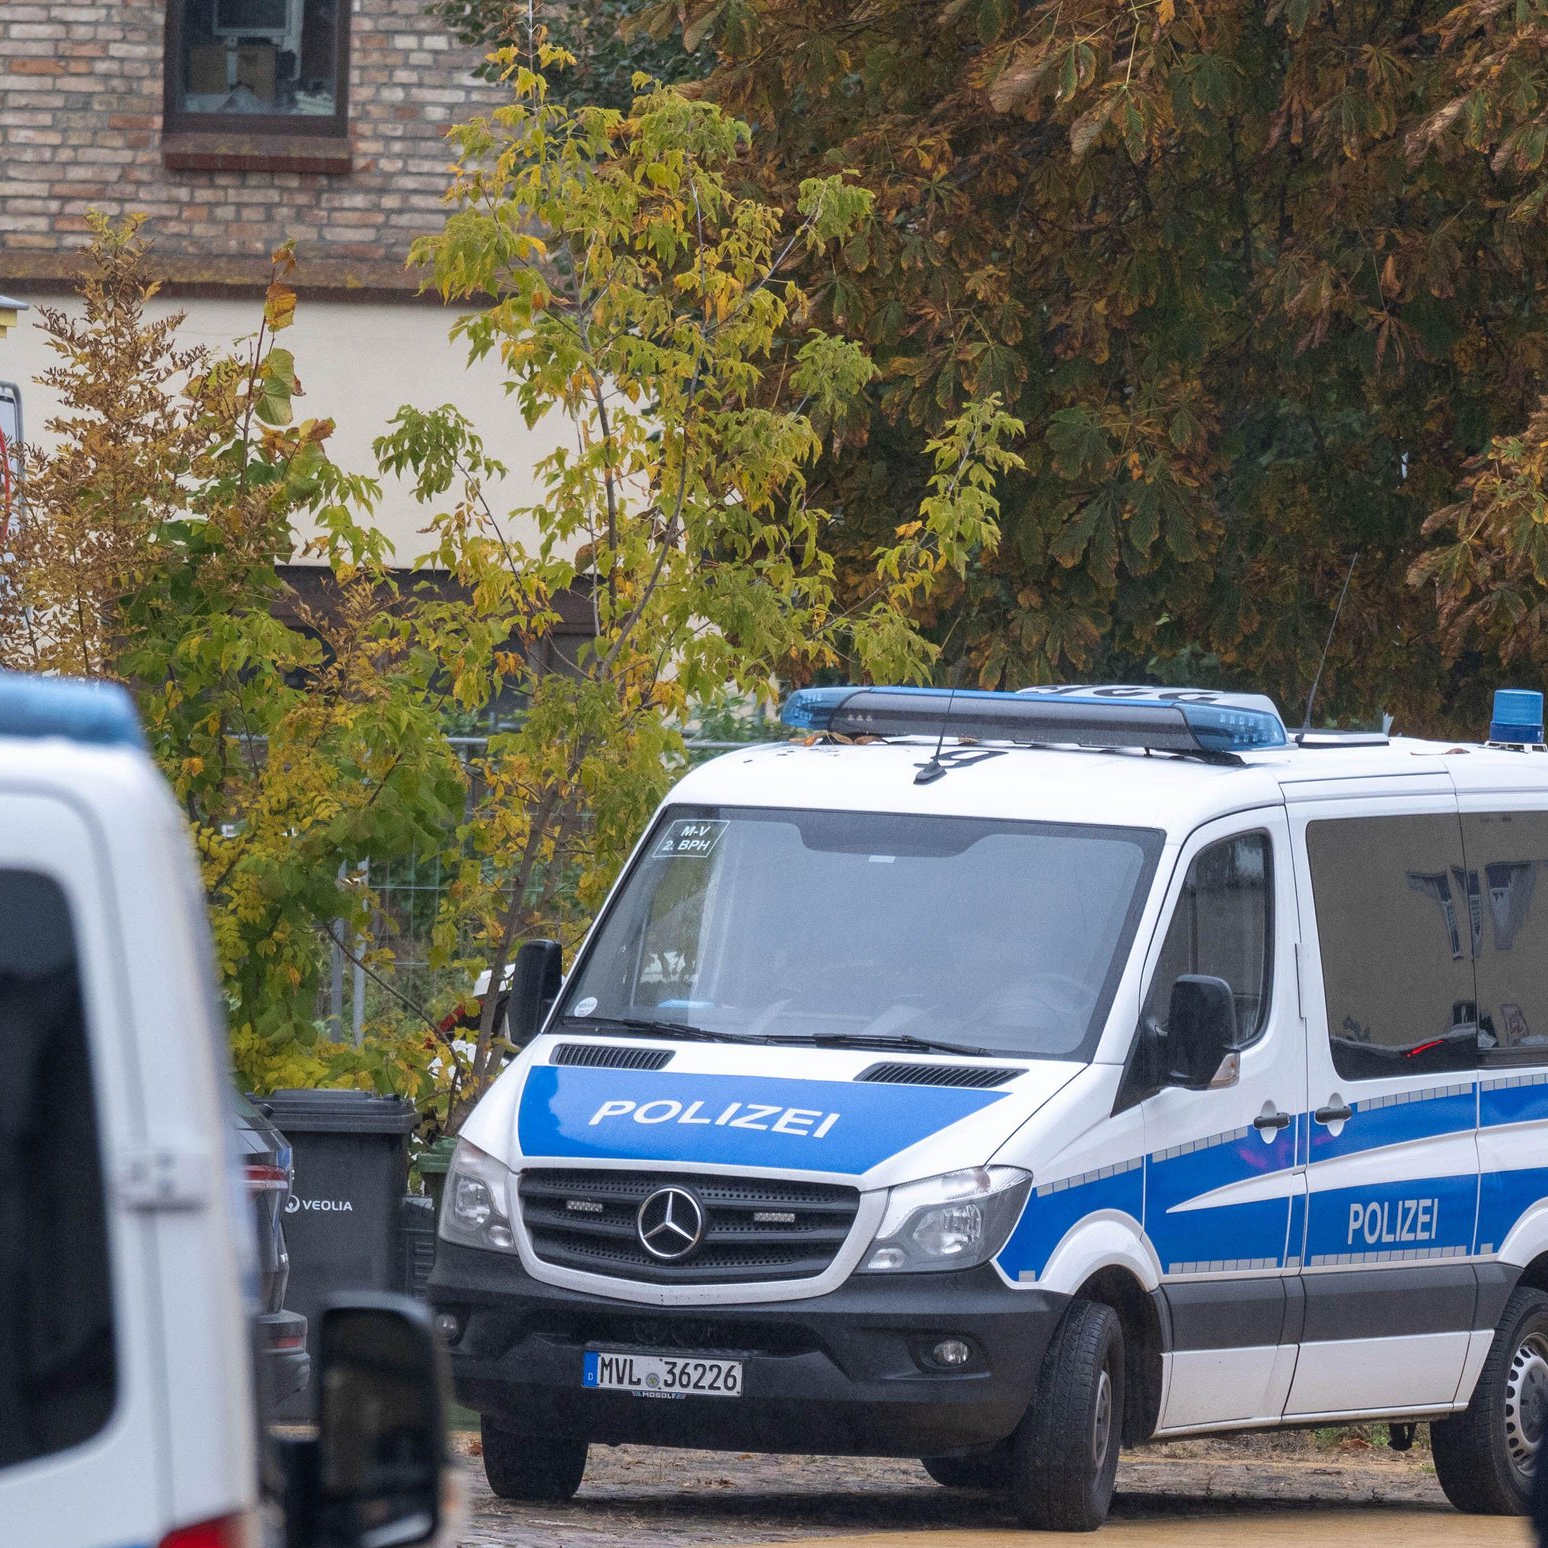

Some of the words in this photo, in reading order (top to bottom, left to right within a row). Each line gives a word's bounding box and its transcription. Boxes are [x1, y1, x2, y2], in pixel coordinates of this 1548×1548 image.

[680, 825, 711, 837] M-V
[662, 840, 674, 851] 2.
[677, 840, 711, 851] BPH
[588, 1100, 840, 1139] POLIZEI
[302, 1200, 353, 1211] VEOLIA
[1347, 1198, 1439, 1245] POLIZEI
[600, 1357, 642, 1386] MVL
[663, 1361, 738, 1391] 36226
